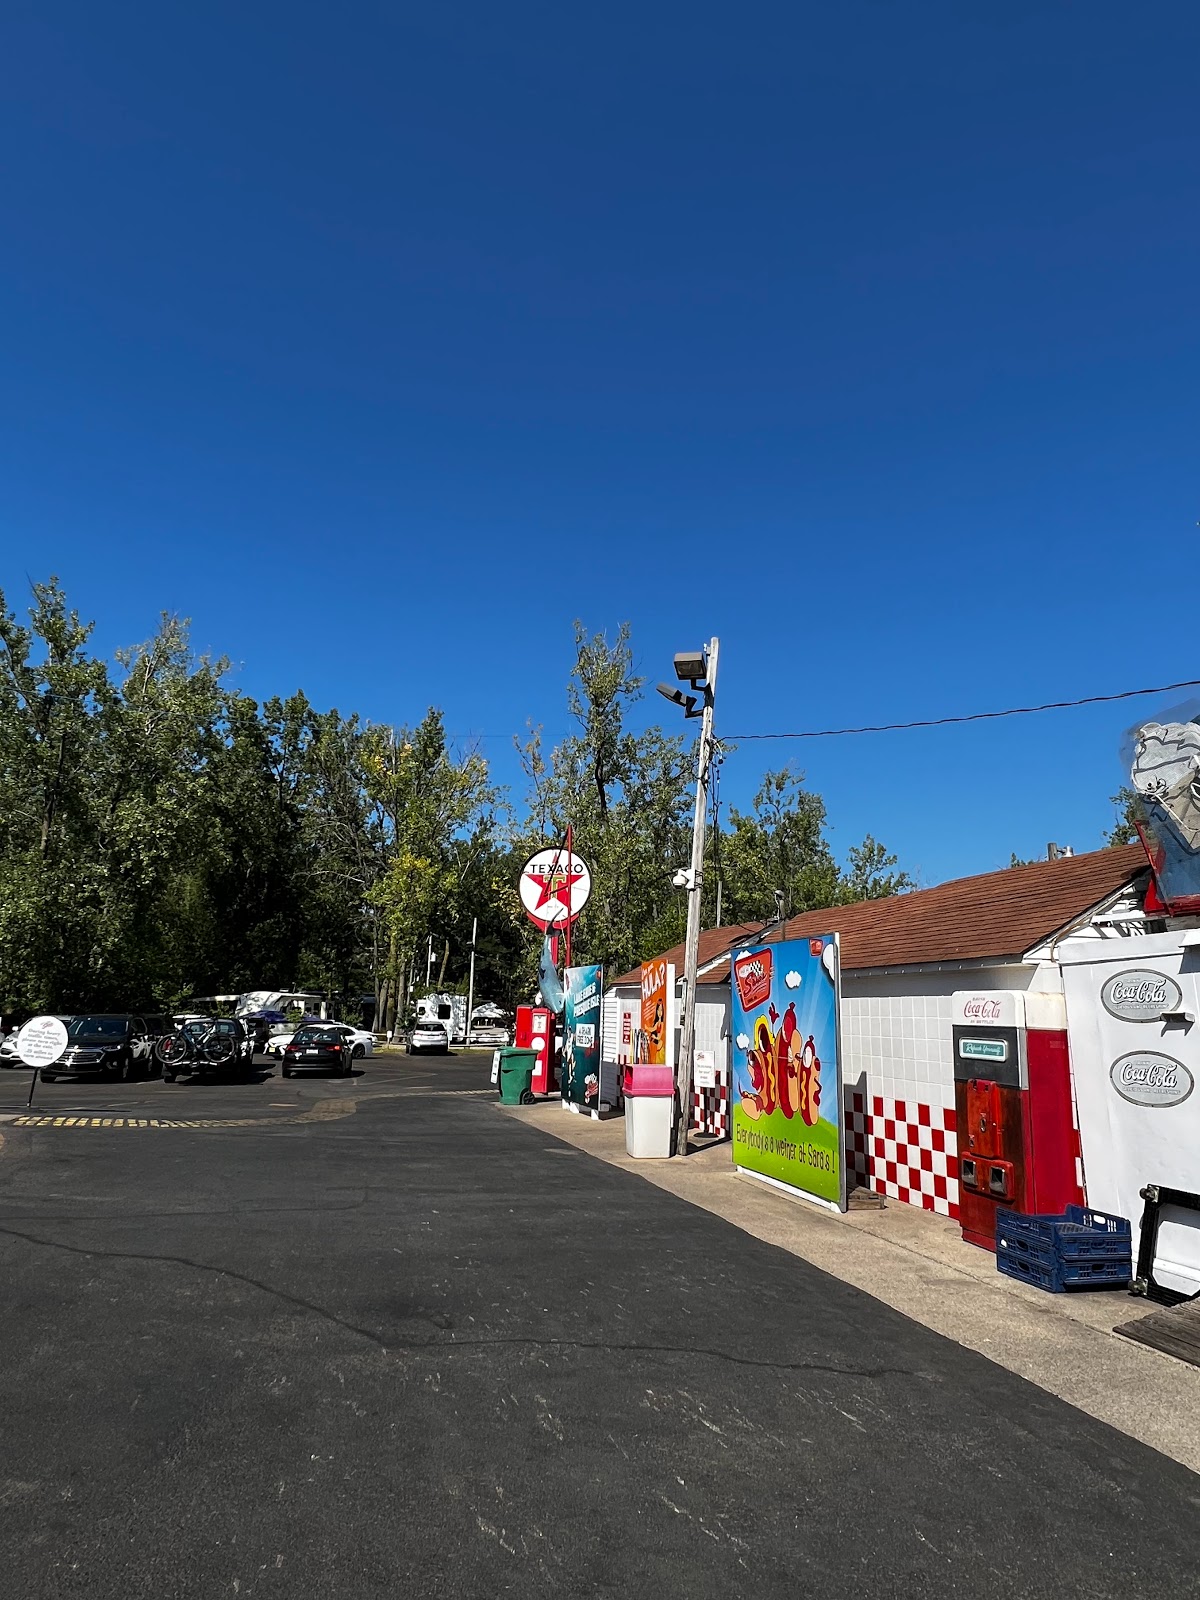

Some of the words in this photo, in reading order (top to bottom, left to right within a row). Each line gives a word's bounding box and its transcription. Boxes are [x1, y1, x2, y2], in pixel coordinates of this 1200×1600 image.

[530, 864, 583, 873] TEXACO
[641, 962, 666, 1002] HULA?
[1111, 979, 1167, 1004] Coca-Cola
[1120, 1062, 1178, 1088] Coca-Cola
[770, 1136, 774, 1153] a
[799, 1142, 807, 1164] at
